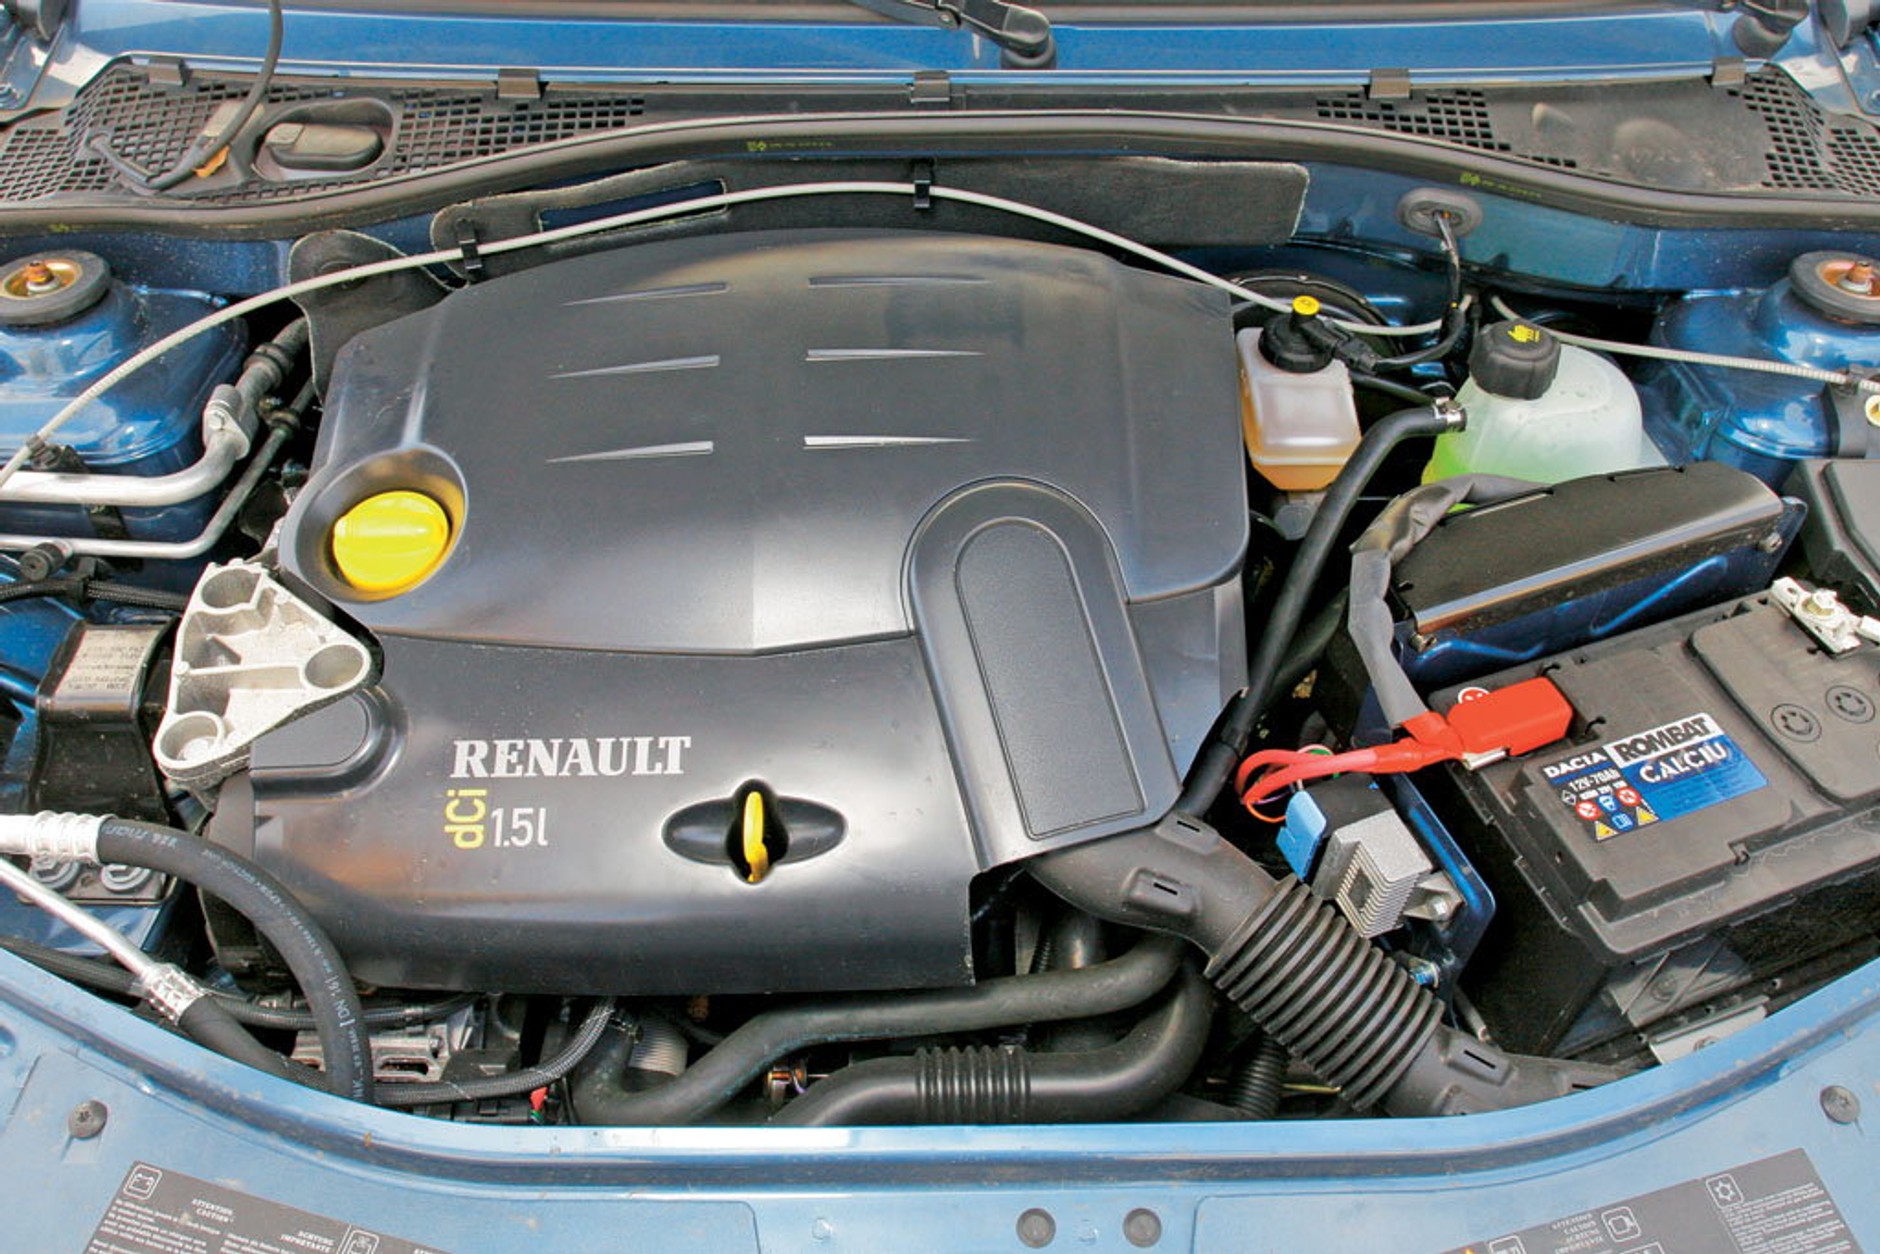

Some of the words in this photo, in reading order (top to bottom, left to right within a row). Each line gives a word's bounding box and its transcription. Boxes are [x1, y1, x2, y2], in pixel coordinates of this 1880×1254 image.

[450, 736, 692, 778] RENAULT
[1613, 717, 1713, 763] ROMBAT
[1543, 752, 1607, 778] DACIA
[1639, 741, 1729, 783] CALCIU
